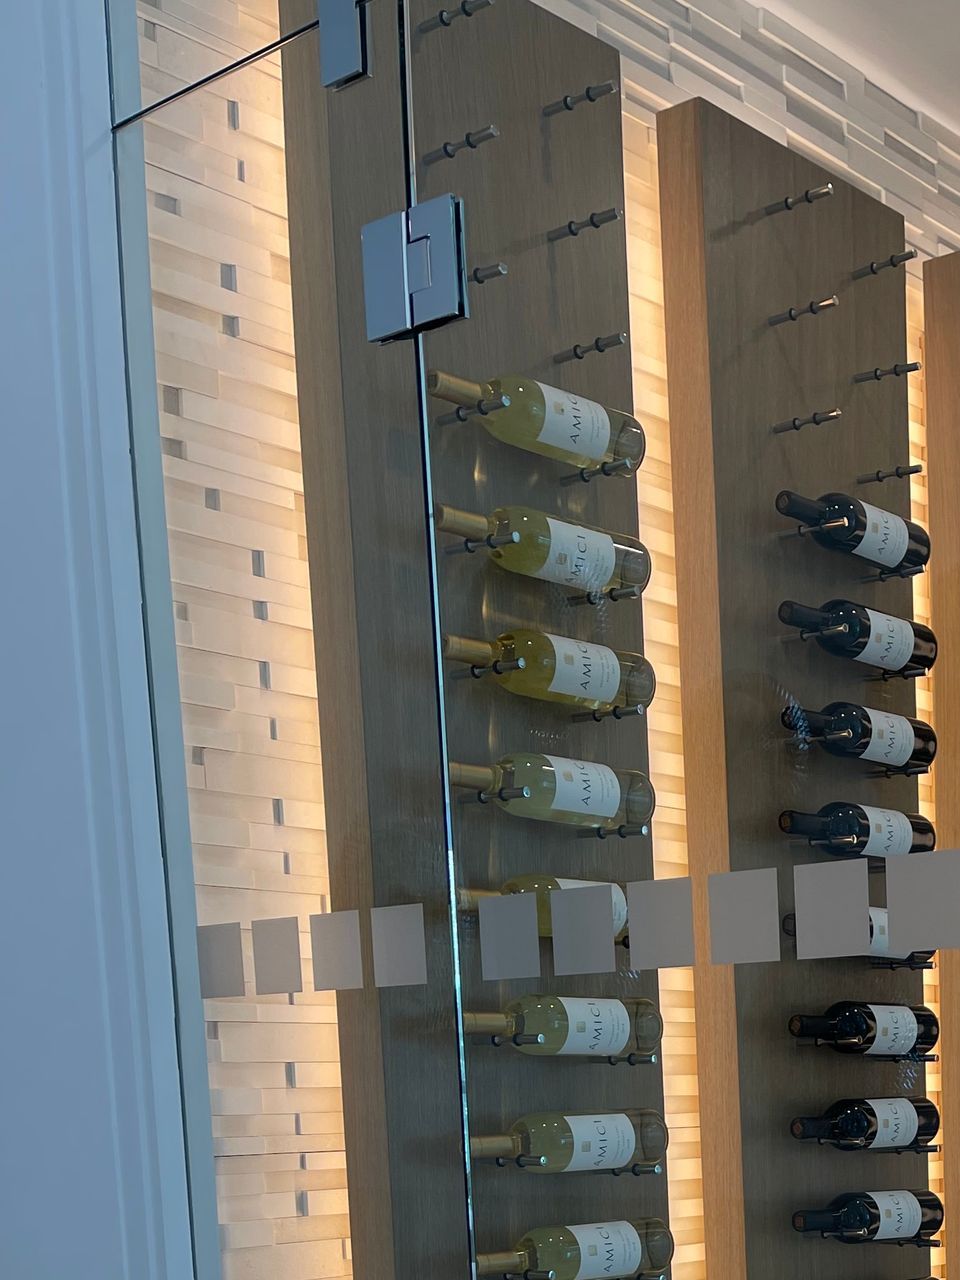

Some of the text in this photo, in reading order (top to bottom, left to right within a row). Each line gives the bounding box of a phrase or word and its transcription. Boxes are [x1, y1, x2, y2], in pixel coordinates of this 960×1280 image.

[587, 1002, 603, 1049] AMICI
[593, 1120, 608, 1167] AMICI
[595, 1226, 614, 1272] AMICI
